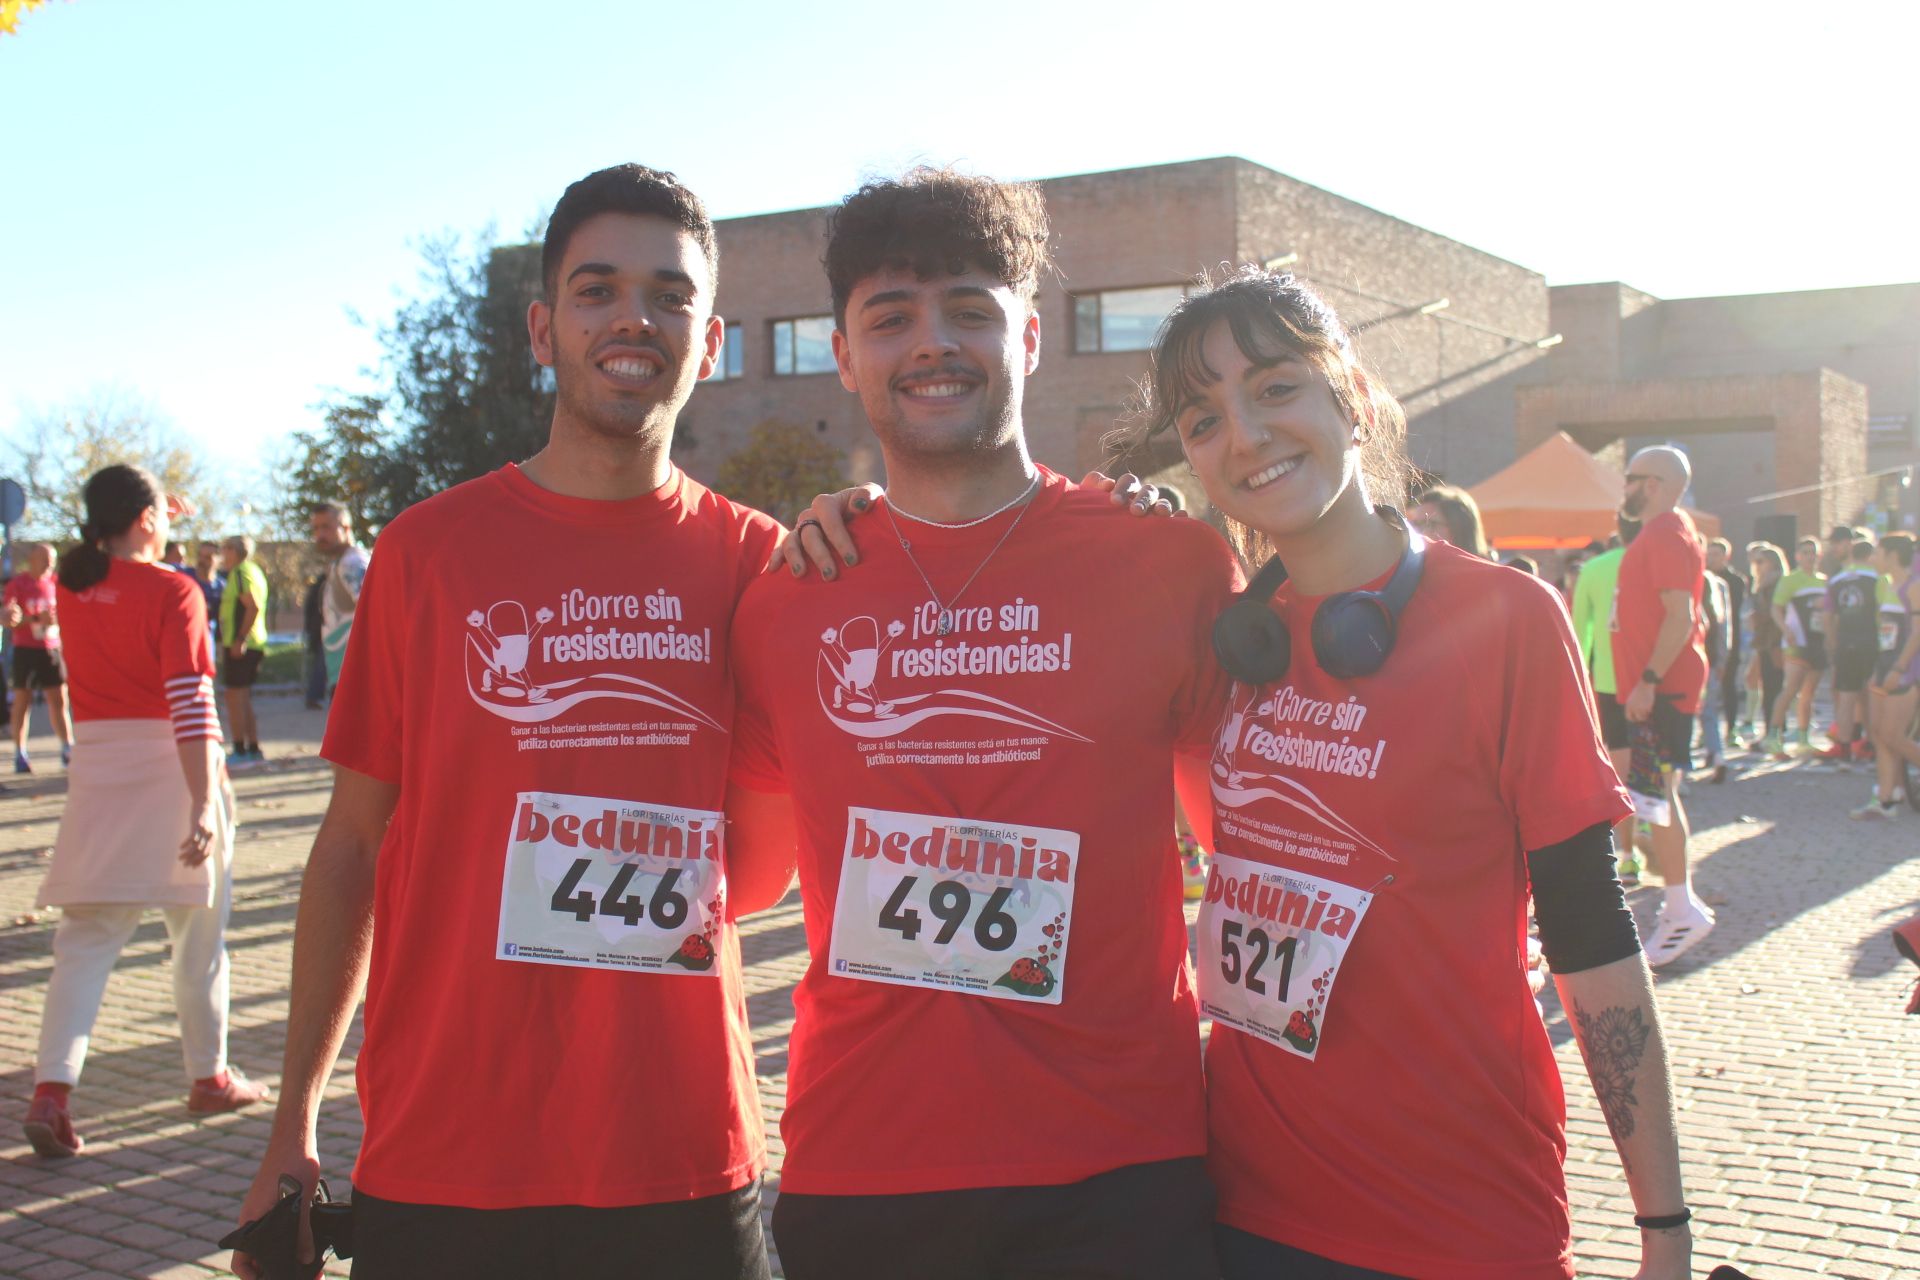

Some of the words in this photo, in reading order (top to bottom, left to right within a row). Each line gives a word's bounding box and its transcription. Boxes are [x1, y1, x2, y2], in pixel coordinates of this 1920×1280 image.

[561, 588, 639, 626] ¡Corre
[645, 588, 682, 621] sin
[913, 600, 992, 640] ¡Corre
[1000, 598, 1039, 632] sin
[543, 625, 711, 664] resistencias!
[892, 633, 1072, 678] resistencias!
[1274, 686, 1332, 726] ¡Corre
[1331, 696, 1367, 732] sin
[512, 726, 530, 736] Ganar
[540, 725, 550, 734] las
[552, 724, 587, 734] bacterias
[589, 722, 630, 732] resistentes
[632, 721, 647, 731] está
[660, 722, 670, 730] tus
[672, 722, 697, 731] manos:
[550, 736, 619, 749] correctamente
[620, 734, 634, 746] los
[636, 734, 690, 746] antibióticos!
[858, 742, 876, 752] Ganar
[884, 740, 896, 749] las
[898, 740, 932, 750] bacterias
[934, 740, 976, 748] resistentes
[978, 738, 994, 748] está
[996, 740, 1004, 748] en
[1006, 738, 1018, 746] tus
[1020, 736, 1048, 745] manos:
[896, 754, 964, 765] correctamente
[966, 752, 980, 764] los
[982, 748, 1040, 764] antibióticos!
[1243, 723, 1386, 780] resistencias!
[622, 808, 685, 824] FLORISTERÍAS
[950, 826, 1018, 840] FLORISTERÍAS
[1261, 823, 1298, 838] resistentes
[1298, 831, 1312, 842] está
[851, 818, 1070, 884] bedunia
[1238, 828, 1284, 850] correctamente
[1284, 841, 1296, 854] los
[1298, 847, 1350, 866] antibióticos!
[551, 858, 688, 930] 446
[1262, 872, 1316, 892] FLORISTERÍAS
[878, 876, 1017, 952] 496
[1205, 864, 1356, 940] bedunia
[1221, 919, 1297, 1002] 521
